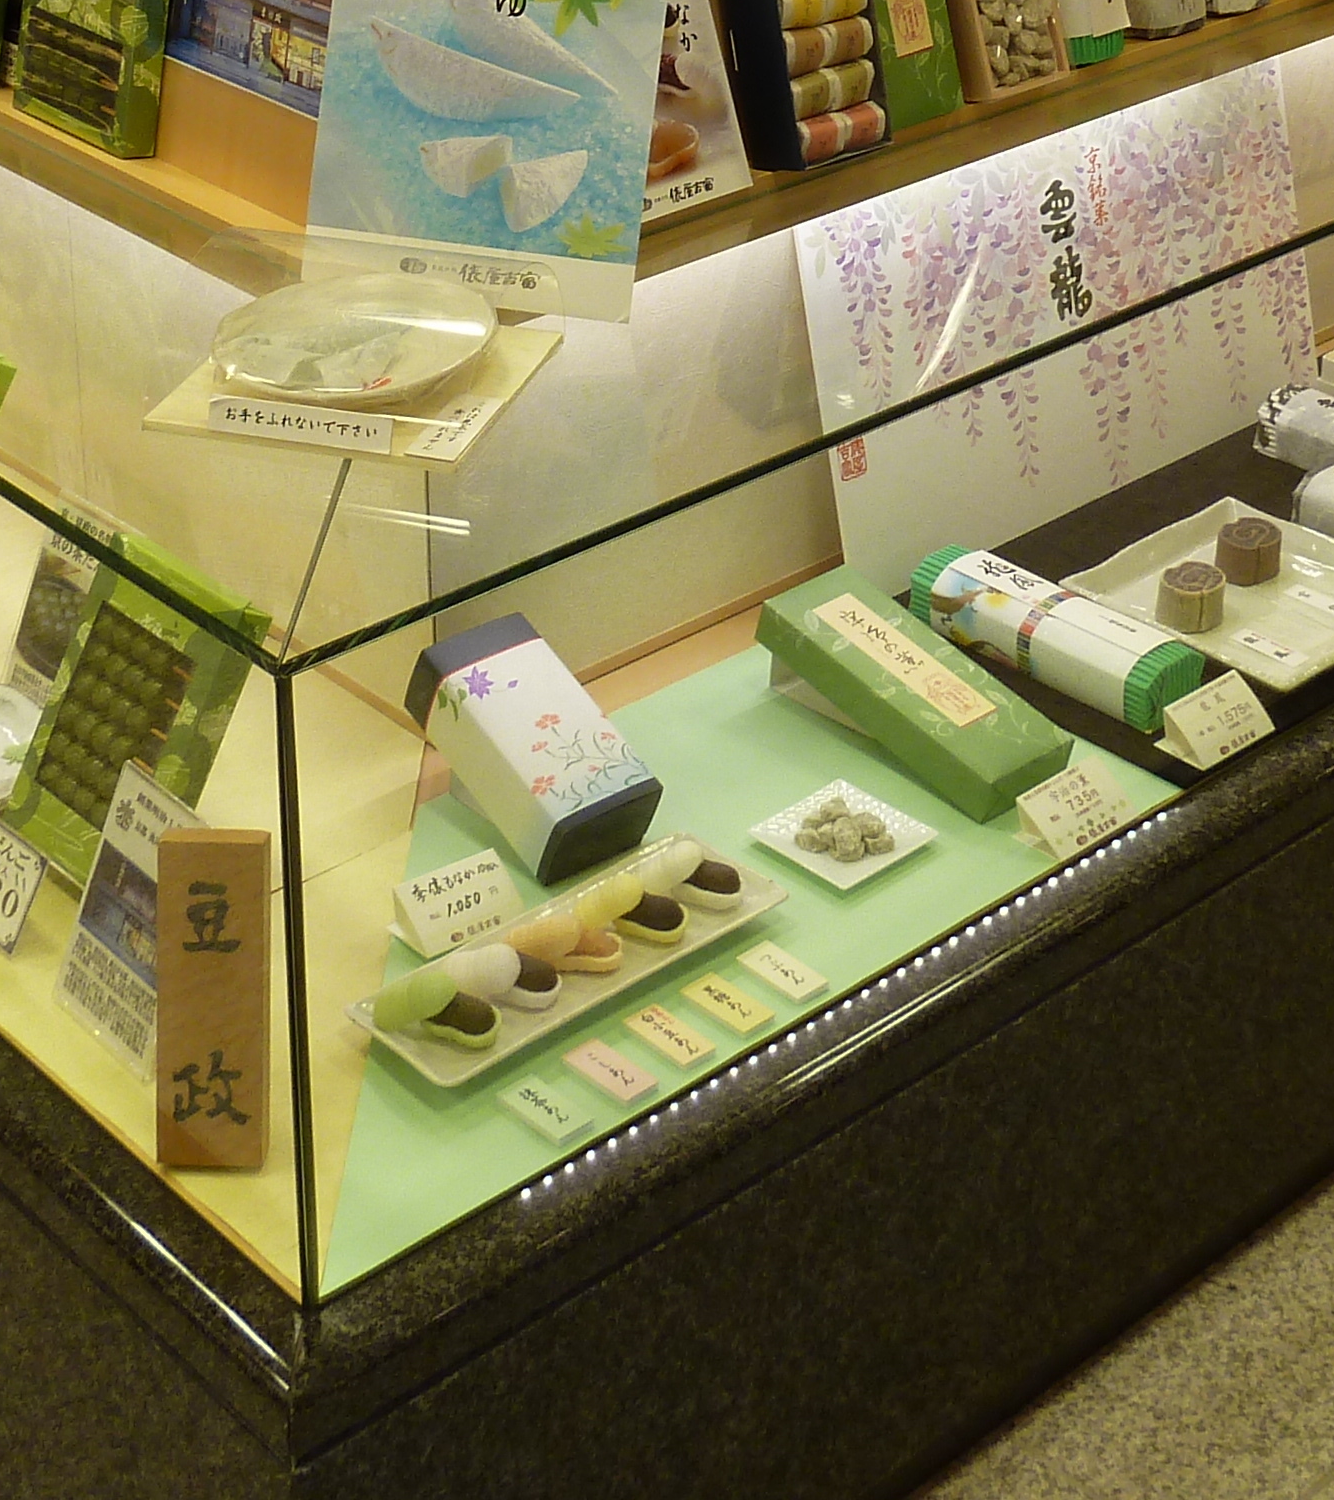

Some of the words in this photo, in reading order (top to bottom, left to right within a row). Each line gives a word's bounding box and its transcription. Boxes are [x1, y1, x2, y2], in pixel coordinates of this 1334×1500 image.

[670, 177, 713, 203] 俵屋吉富
[1084, 147, 1108, 226] 京銘菓
[459, 264, 540, 289] 俵屋吉富
[1040, 180, 1092, 321] 雲龍
[226, 408, 377, 437] お手をふれないで下さい
[172, 881, 252, 1126] 豆政
